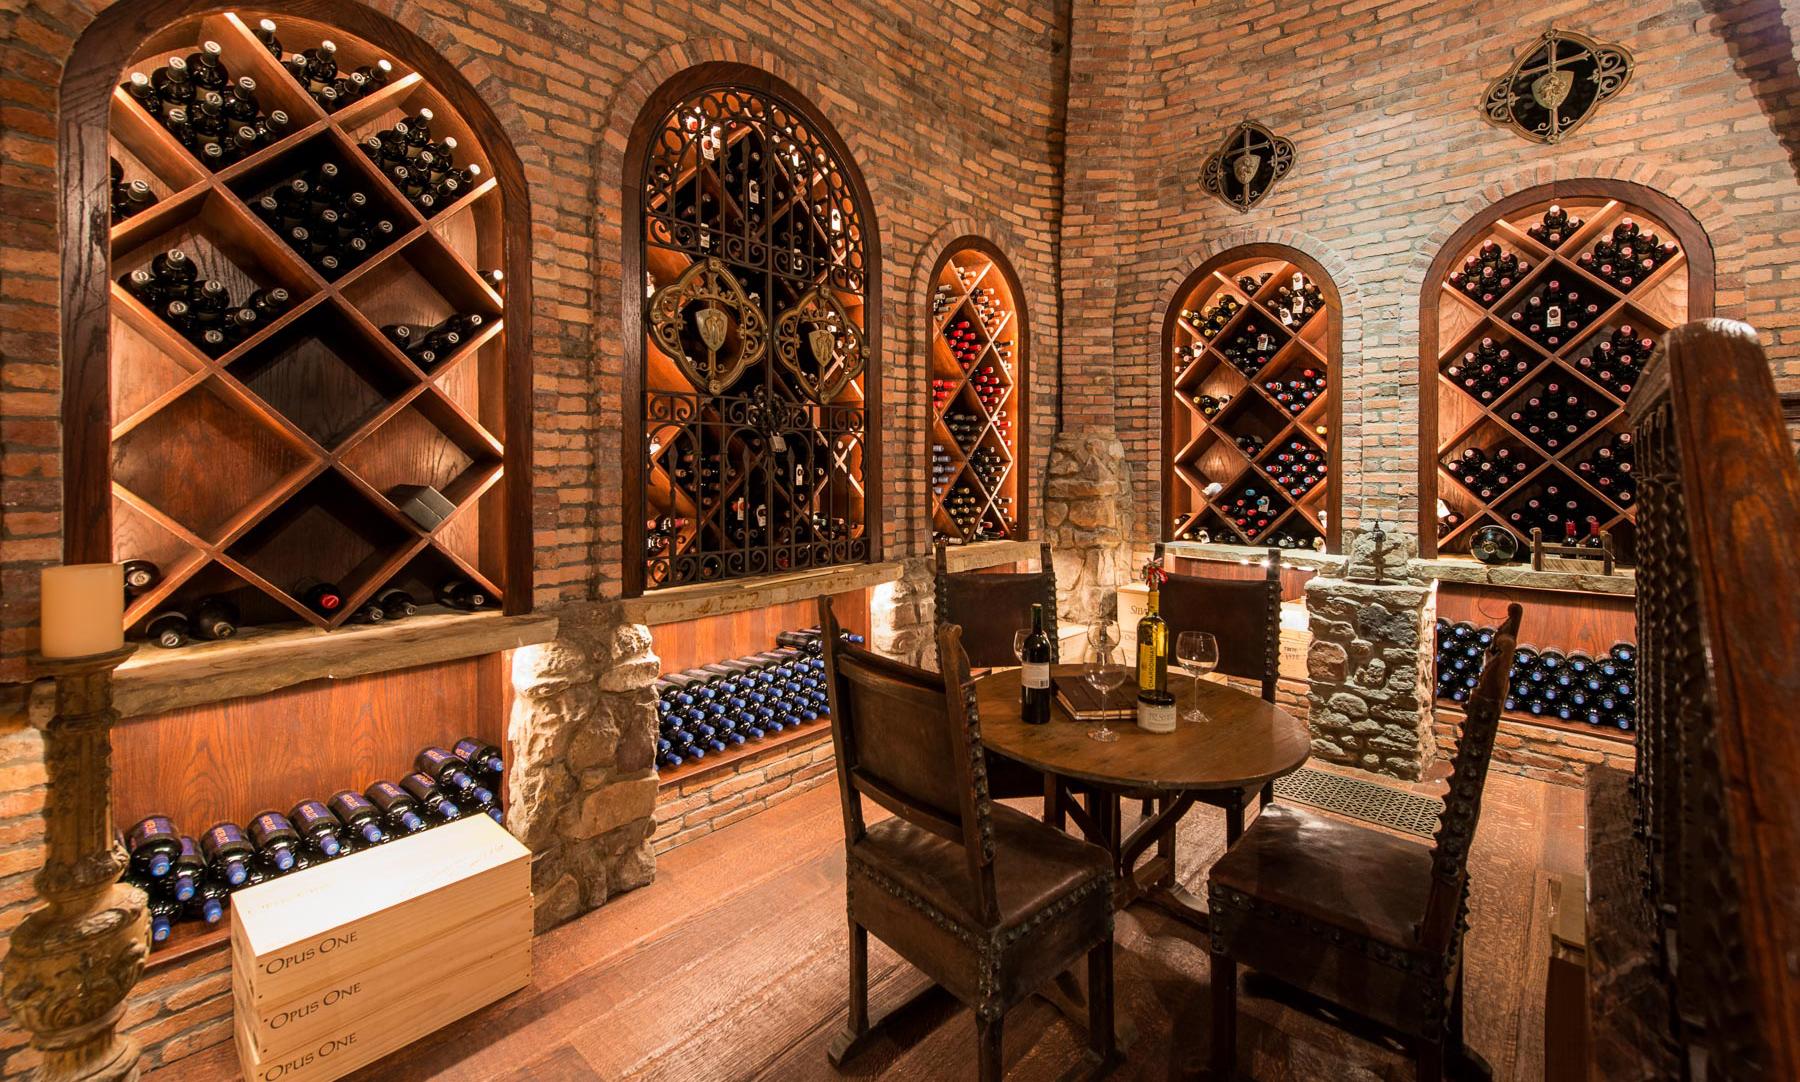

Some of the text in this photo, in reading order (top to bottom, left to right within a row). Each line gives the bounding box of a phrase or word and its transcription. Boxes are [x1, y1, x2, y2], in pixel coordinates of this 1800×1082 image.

[265, 931, 359, 975] OPUS ONE
[270, 982, 362, 1030] OPUS ONE
[265, 1032, 358, 1082] OPUS ONE
